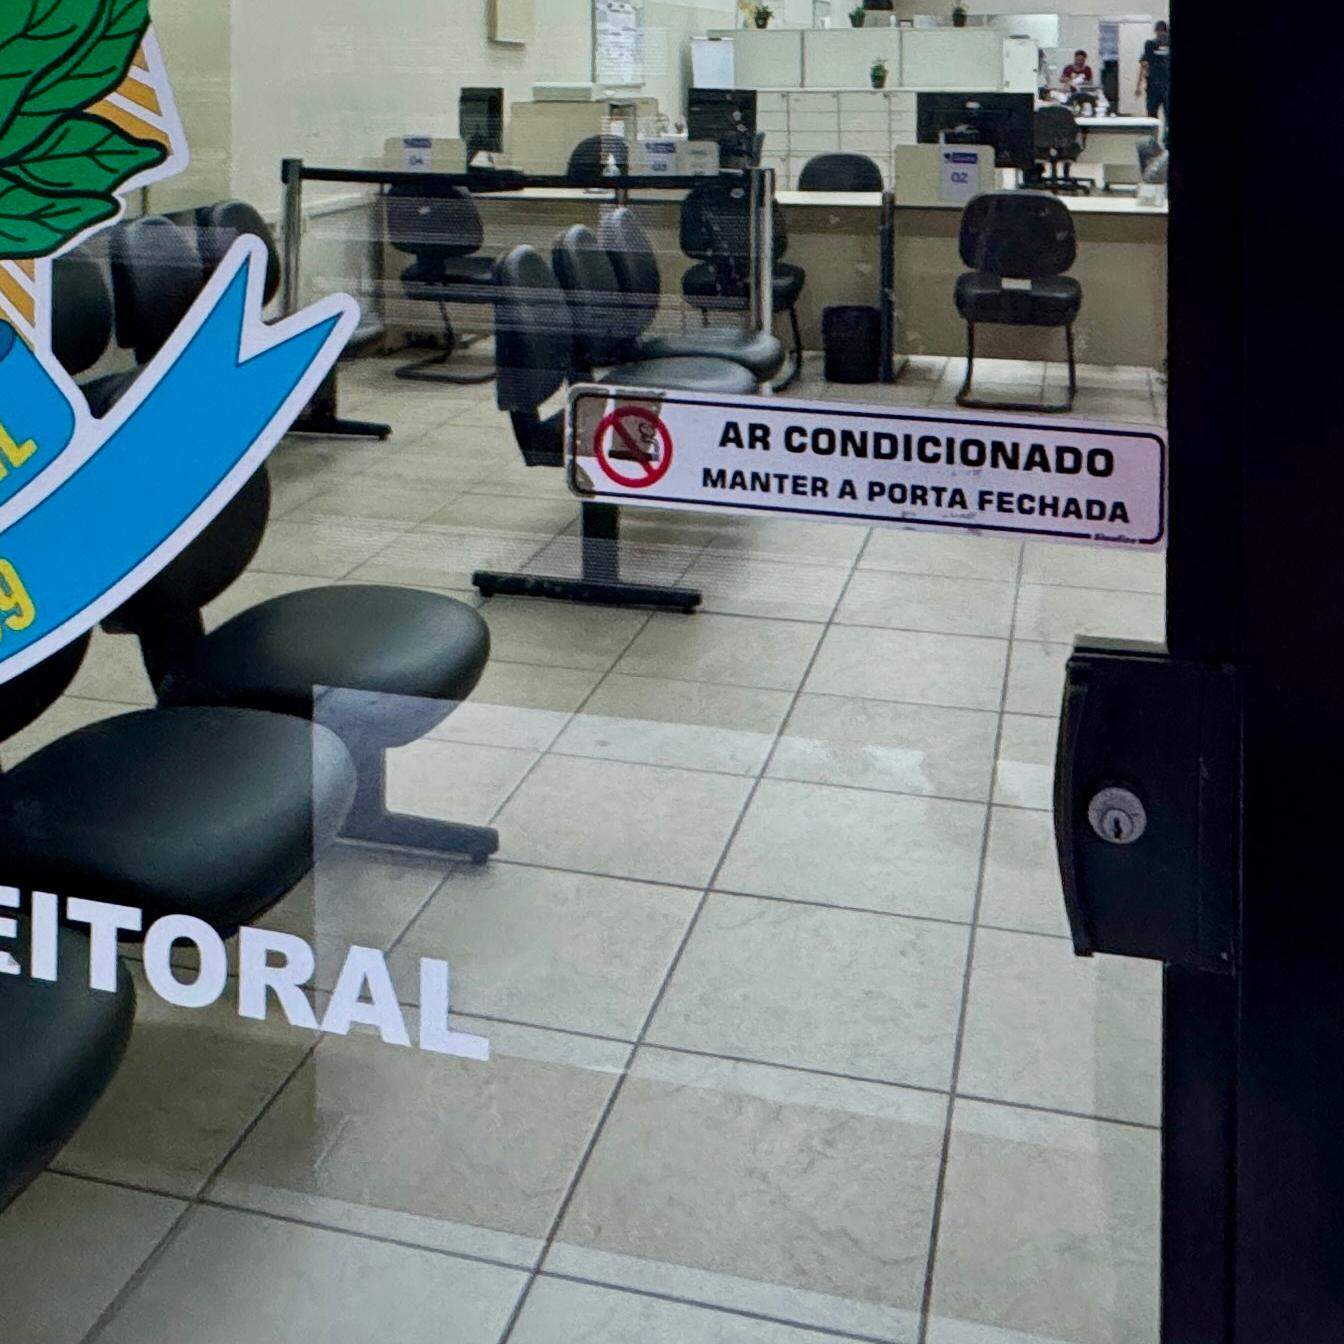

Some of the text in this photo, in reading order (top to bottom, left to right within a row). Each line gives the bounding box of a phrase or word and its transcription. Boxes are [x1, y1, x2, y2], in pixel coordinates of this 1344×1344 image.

[951, 172, 968, 183] 02
[719, 421, 1114, 477] AR CONDICIONADO
[702, 468, 1130, 524] MANTER A PORTA FECHADA
